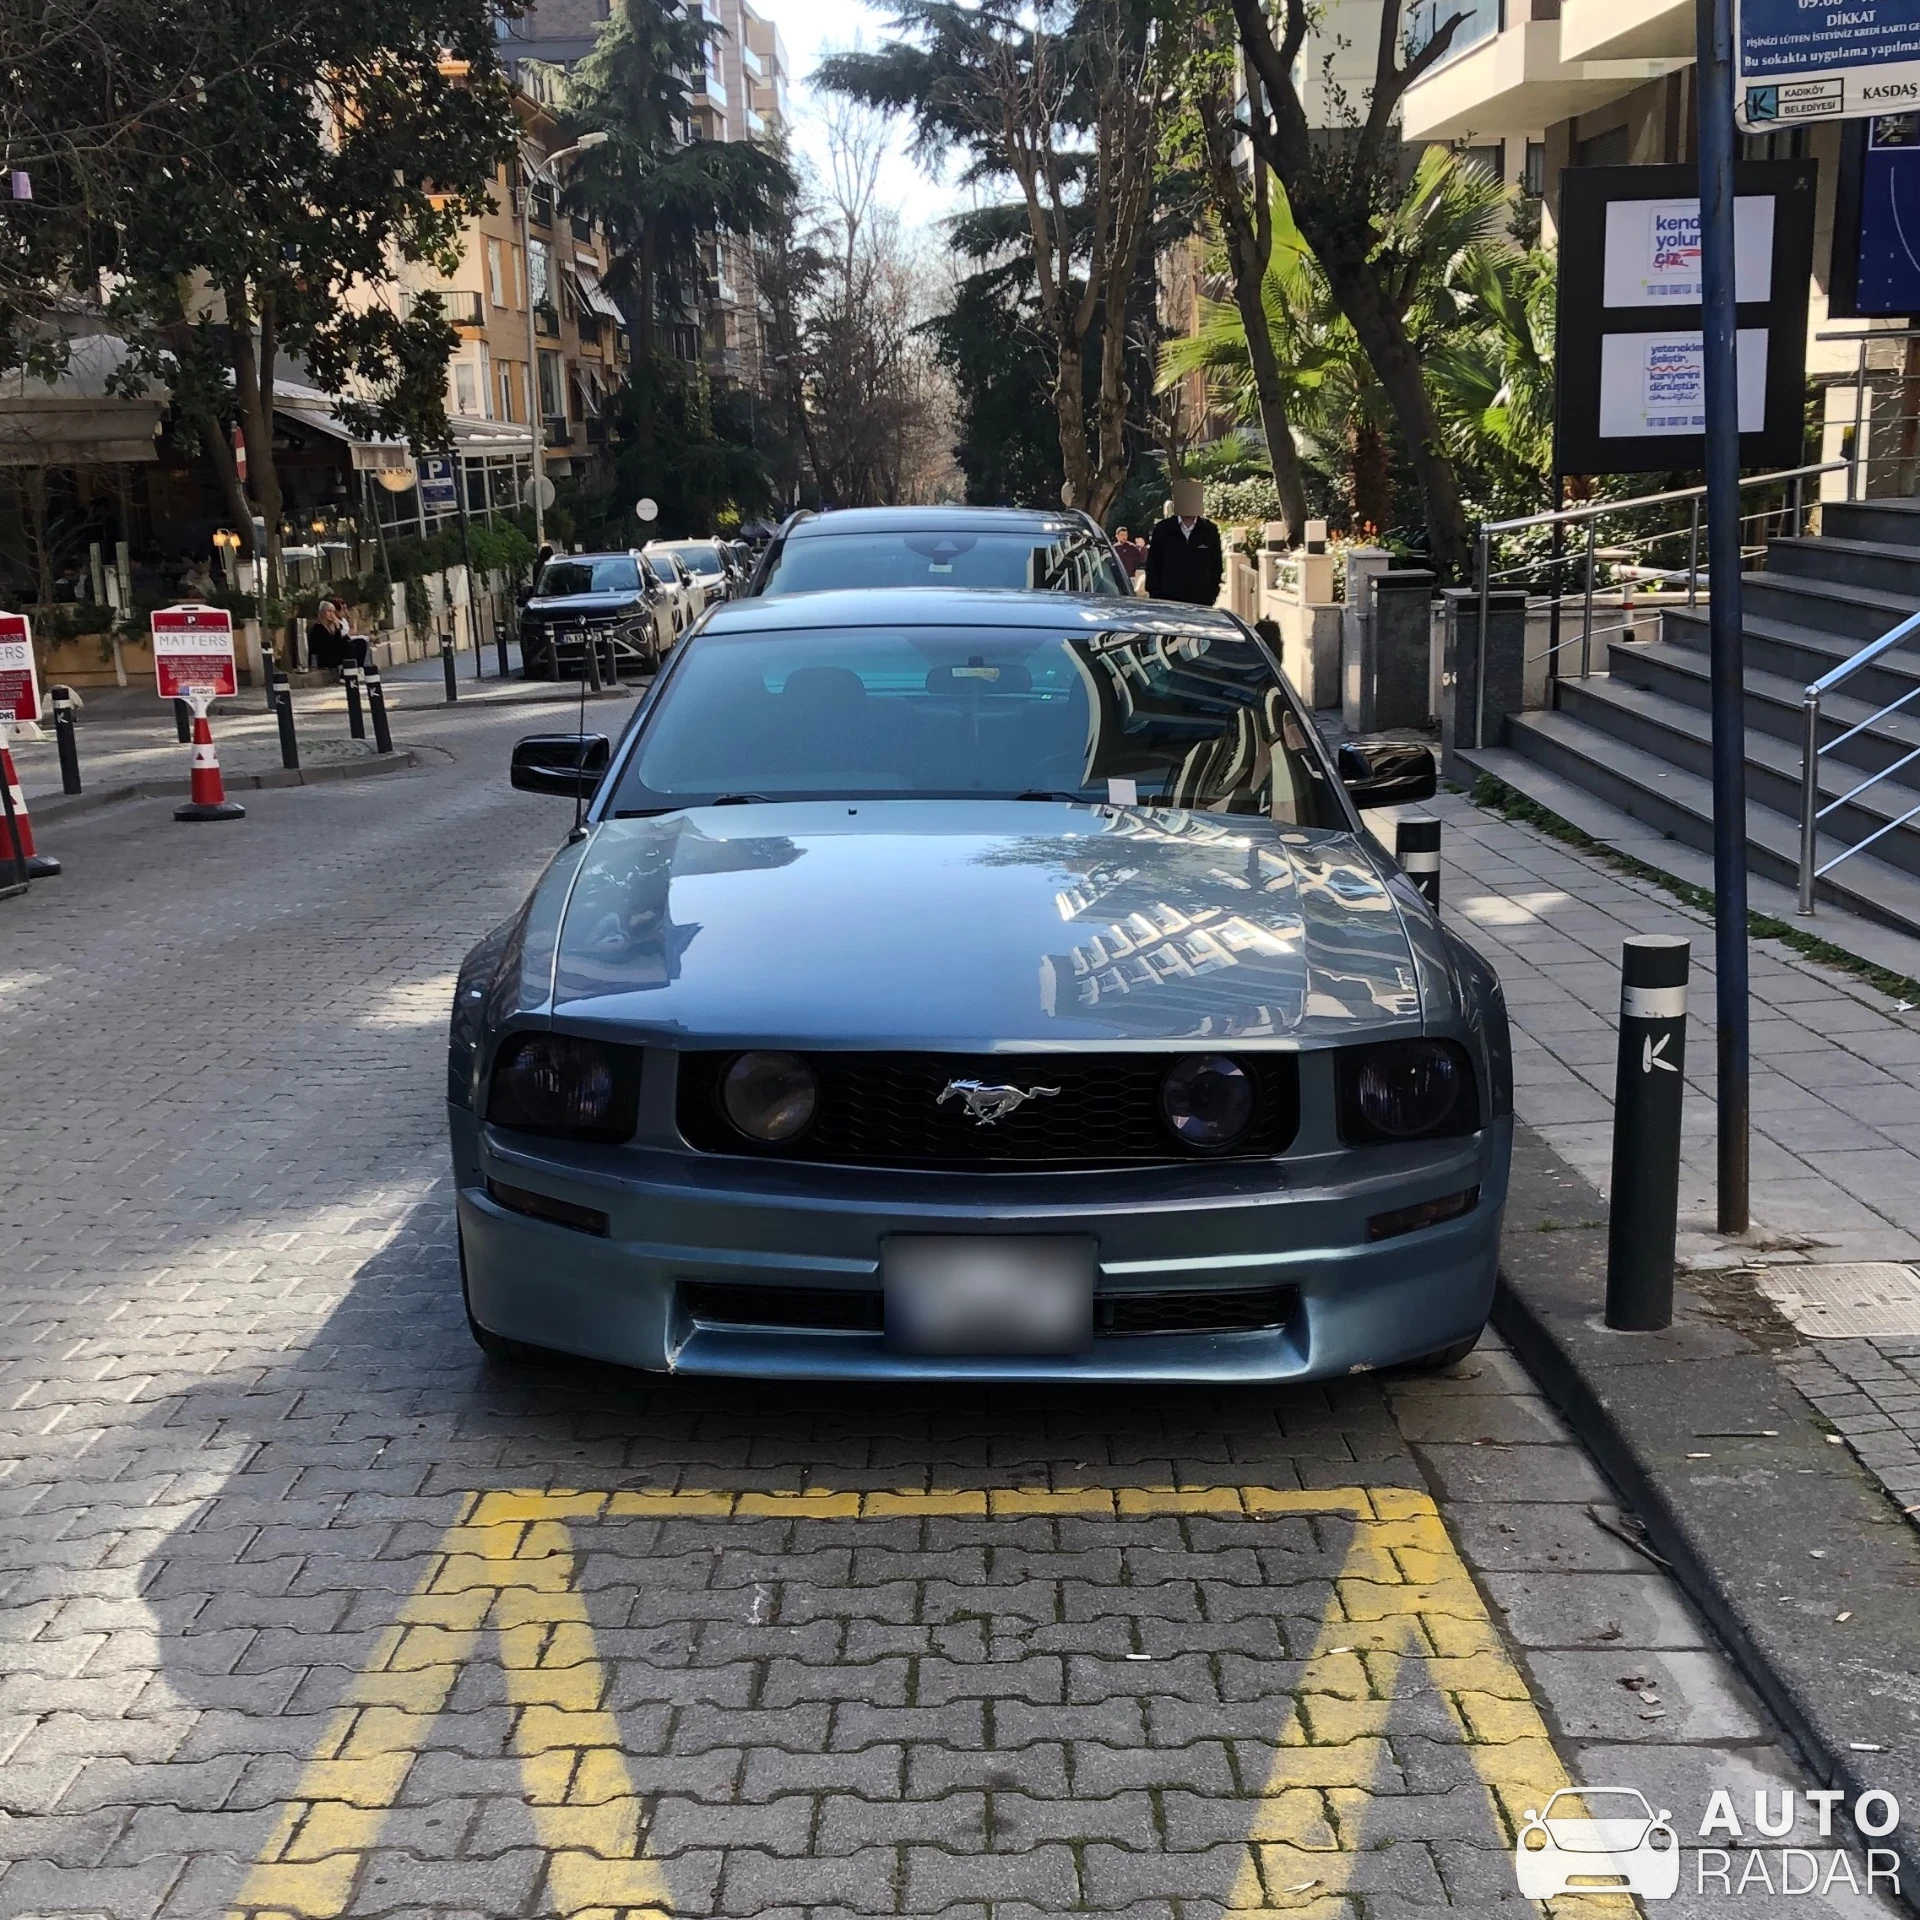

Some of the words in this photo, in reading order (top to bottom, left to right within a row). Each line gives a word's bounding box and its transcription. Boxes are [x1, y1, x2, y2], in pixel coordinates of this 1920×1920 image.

[1826, 10, 1877, 27] DİKKAT
[1812, 28, 1853, 42] İSTEYİNİZ
[1854, 26, 1880, 37] KREDİ
[1881, 23, 1907, 34] KARTI
[1744, 56, 1759, 67] Bu
[1762, 52, 1807, 66] sokakta
[1810, 46, 1868, 63] uygulama
[1784, 85, 1825, 98] KADIKÖY
[1862, 82, 1918, 100] KASDAŞ
[1784, 101, 1836, 114] BELEDİYESİ
[428, 460, 443, 479] P
[159, 635, 228, 646] MATTERS
[1642, 1033, 1679, 1073] K
